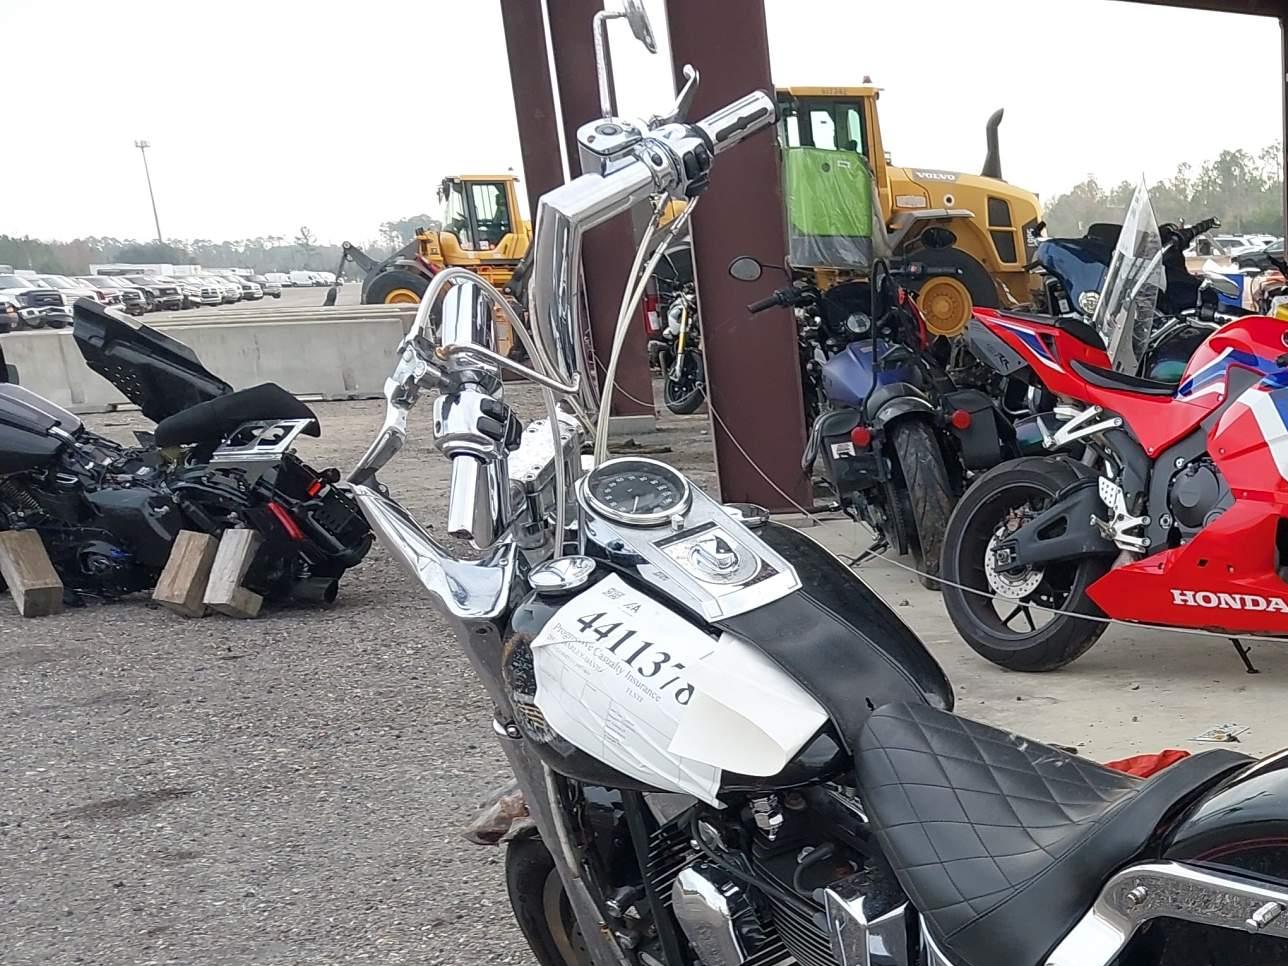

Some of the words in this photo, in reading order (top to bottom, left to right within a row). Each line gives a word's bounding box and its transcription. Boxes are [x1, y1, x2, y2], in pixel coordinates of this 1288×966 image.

[916, 171, 956, 181] VOLVO
[552, 622, 595, 653] Progrve
[592, 644, 626, 675] Casualty
[624, 669, 663, 703] Insurance
